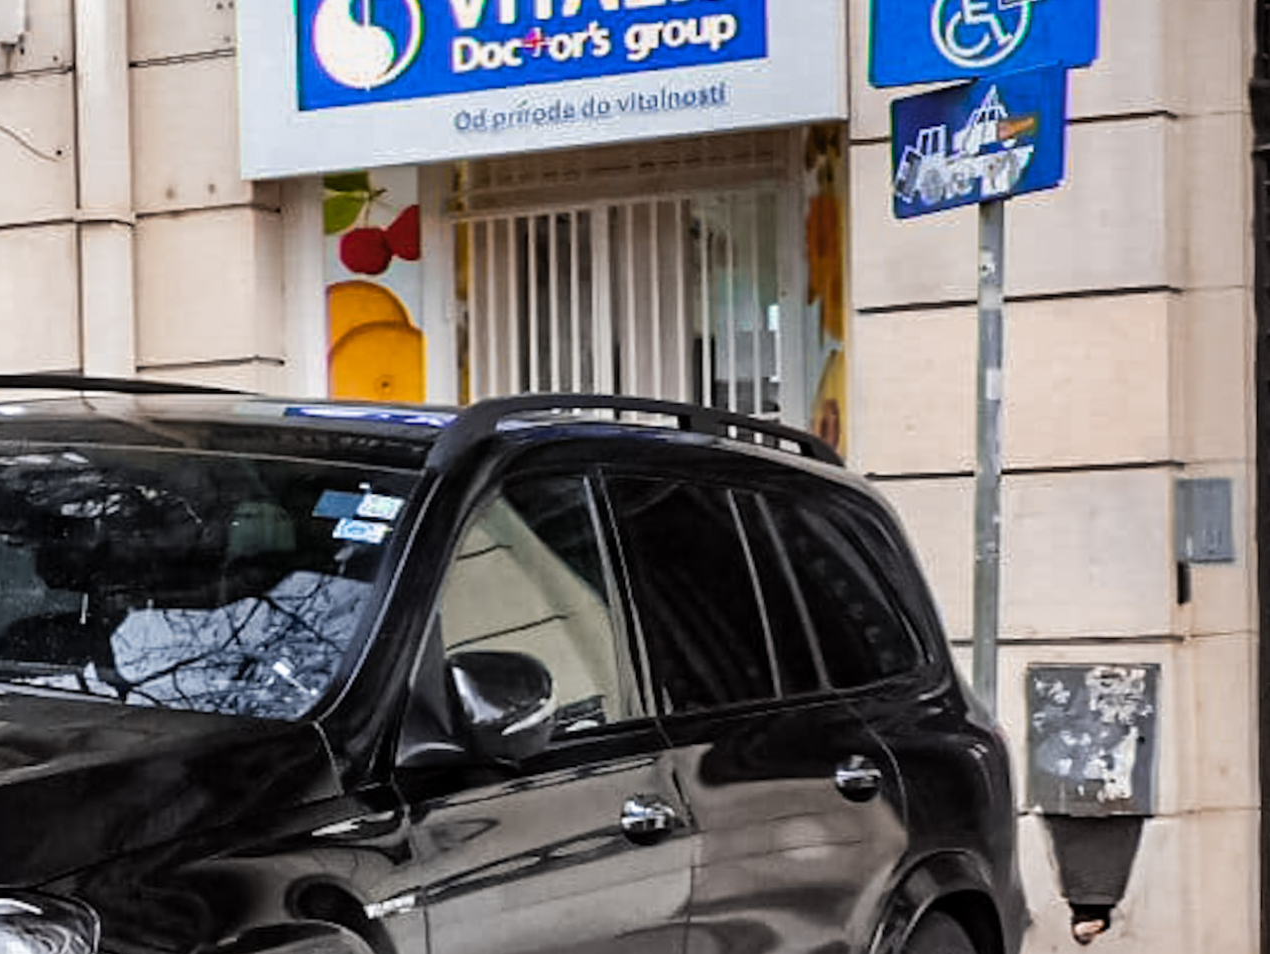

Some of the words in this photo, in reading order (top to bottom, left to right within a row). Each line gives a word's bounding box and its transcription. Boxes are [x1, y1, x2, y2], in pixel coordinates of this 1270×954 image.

[624, 13, 738, 61] group
[454, 109, 486, 130] Od
[583, 97, 610, 119] do
[618, 82, 726, 112] vitalnosti
